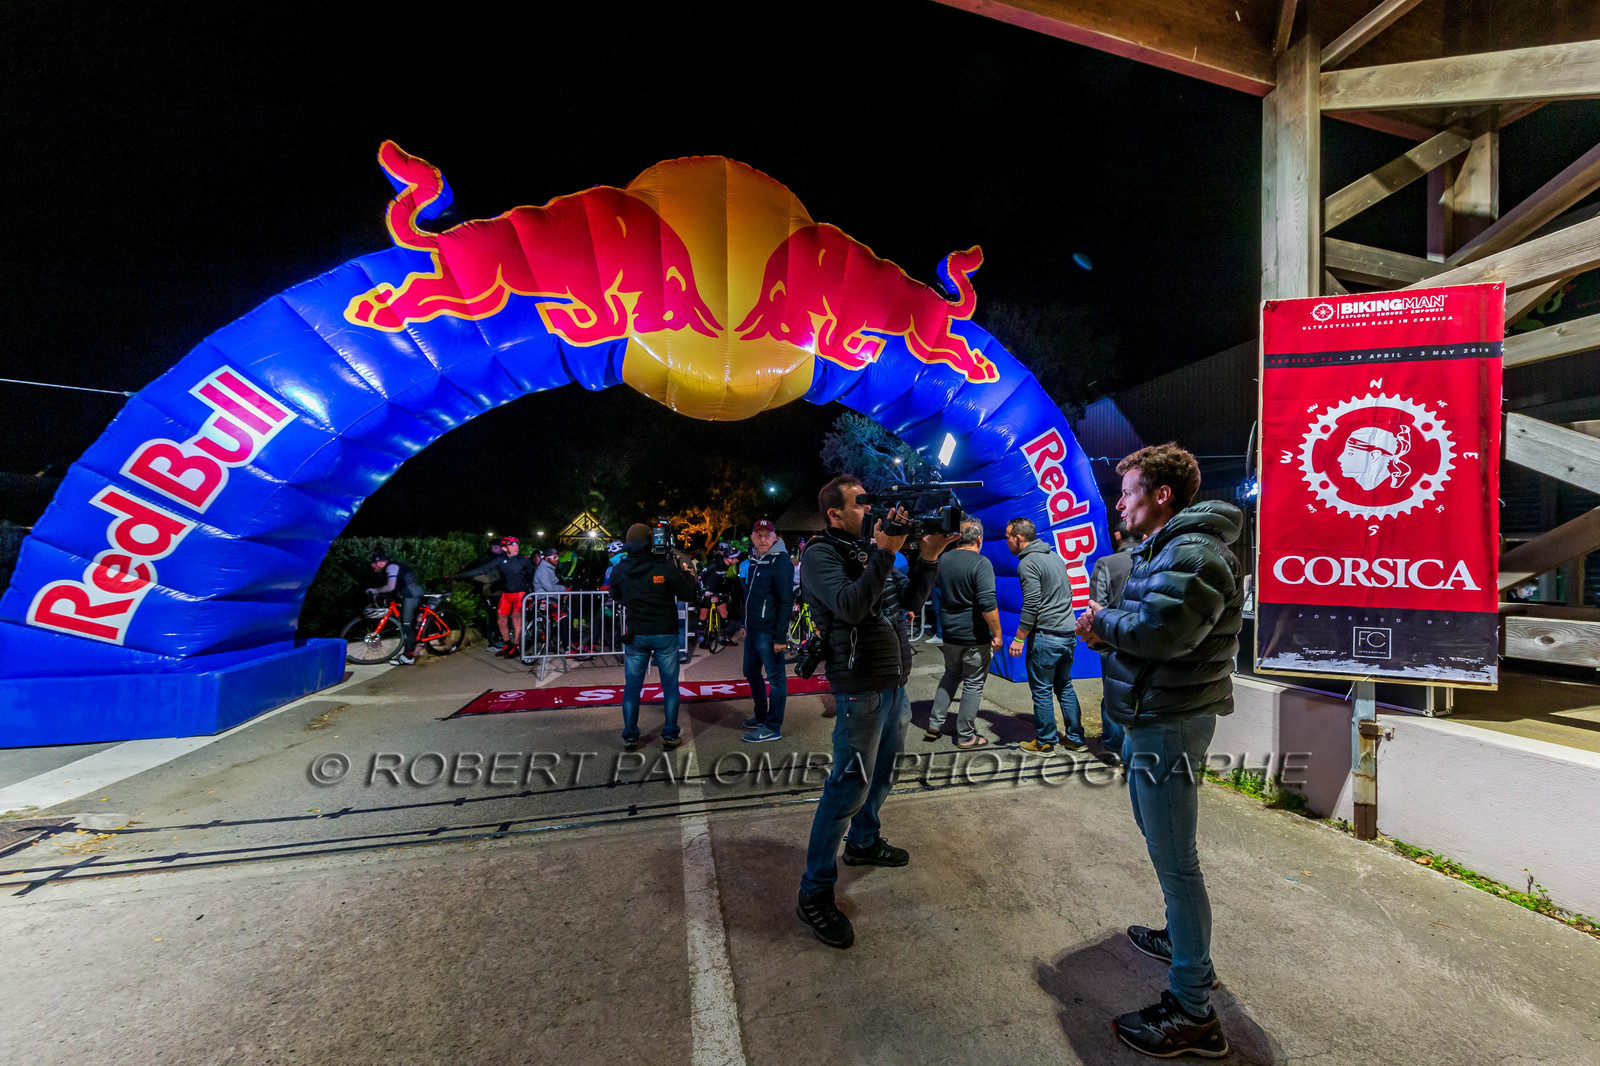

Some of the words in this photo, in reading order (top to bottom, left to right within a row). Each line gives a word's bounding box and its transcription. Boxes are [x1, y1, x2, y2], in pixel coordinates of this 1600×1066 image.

[1341, 295, 1445, 315] BIKINGMAN
[1302, 321, 1367, 330] ULTRACYCLING
[1413, 315, 1453, 323] CORSICA
[1369, 352, 1402, 360] APRIL
[1369, 377, 1383, 389] N
[1021, 428, 1089, 525] Red
[28, 486, 196, 644] Red
[122, 367, 297, 512] Bull
[1368, 525, 1380, 536] S
[1273, 555, 1482, 591] CORSICA
[1298, 613, 1402, 623] POWERED
